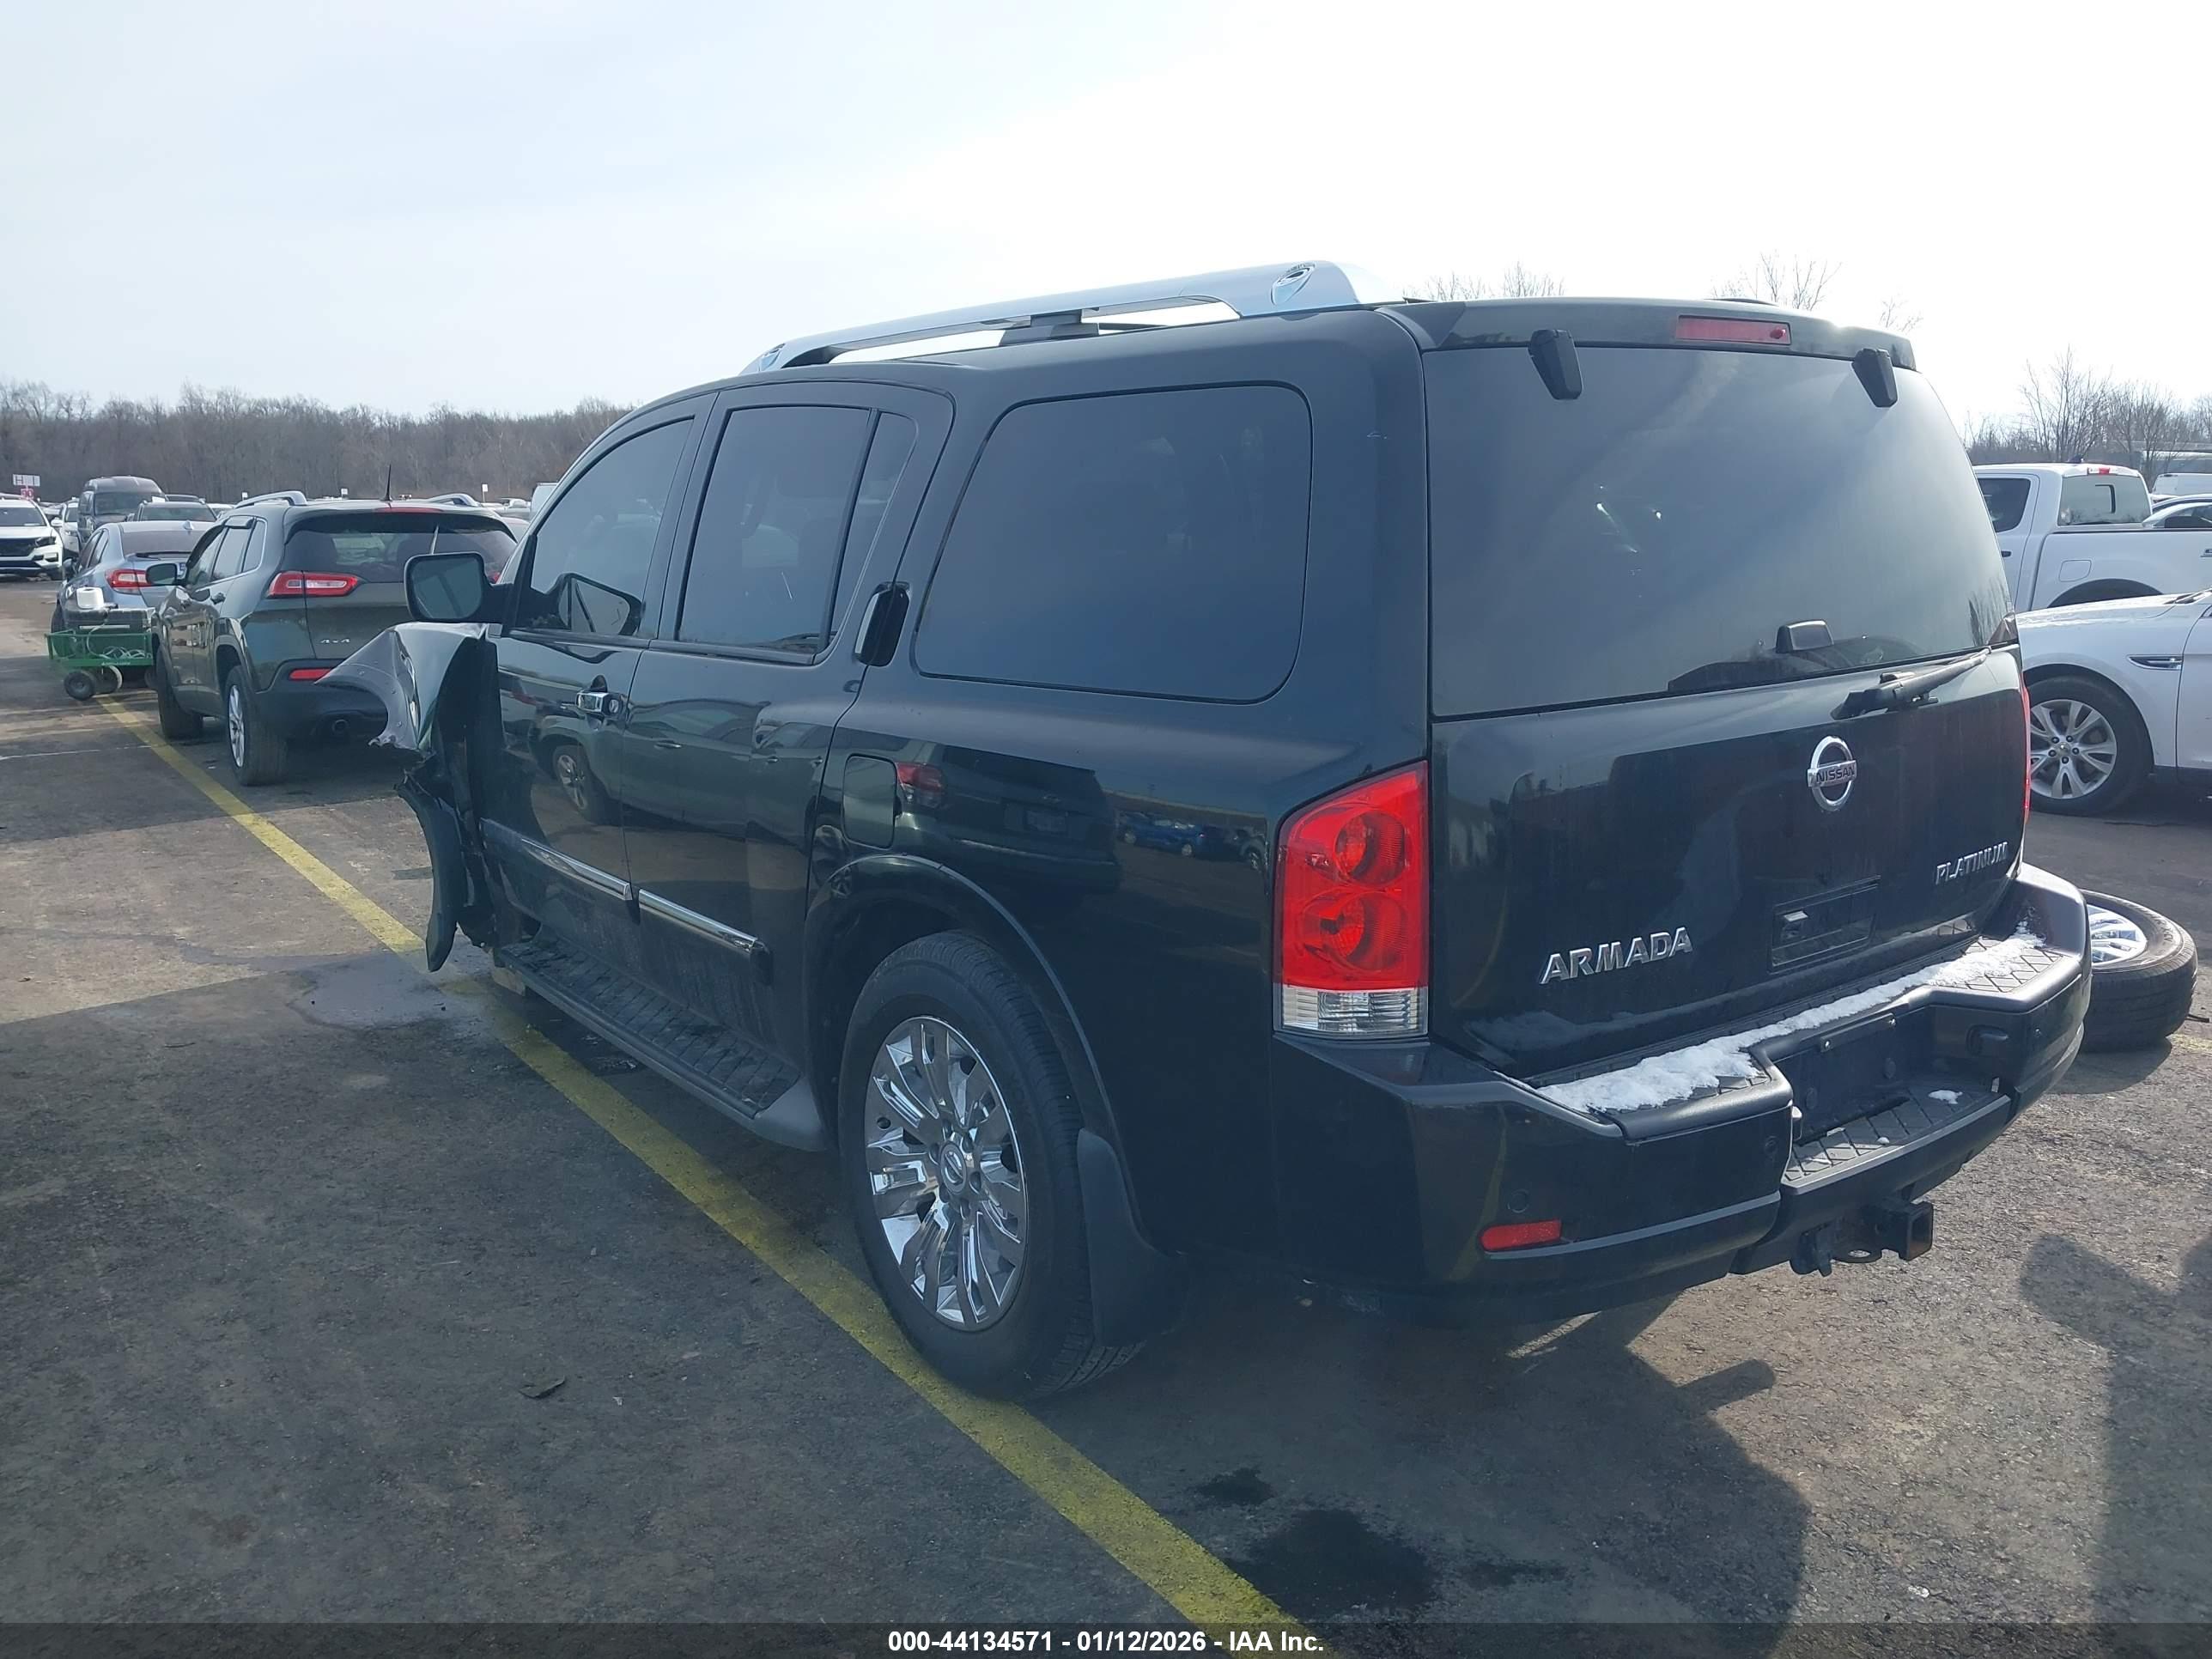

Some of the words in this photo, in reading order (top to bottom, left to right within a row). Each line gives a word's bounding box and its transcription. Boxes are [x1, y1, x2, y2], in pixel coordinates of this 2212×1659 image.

[1816, 766, 1855, 782] NISSAN
[1936, 842, 2008, 885] PLATINUM
[1540, 927, 1693, 985] ARMADA
